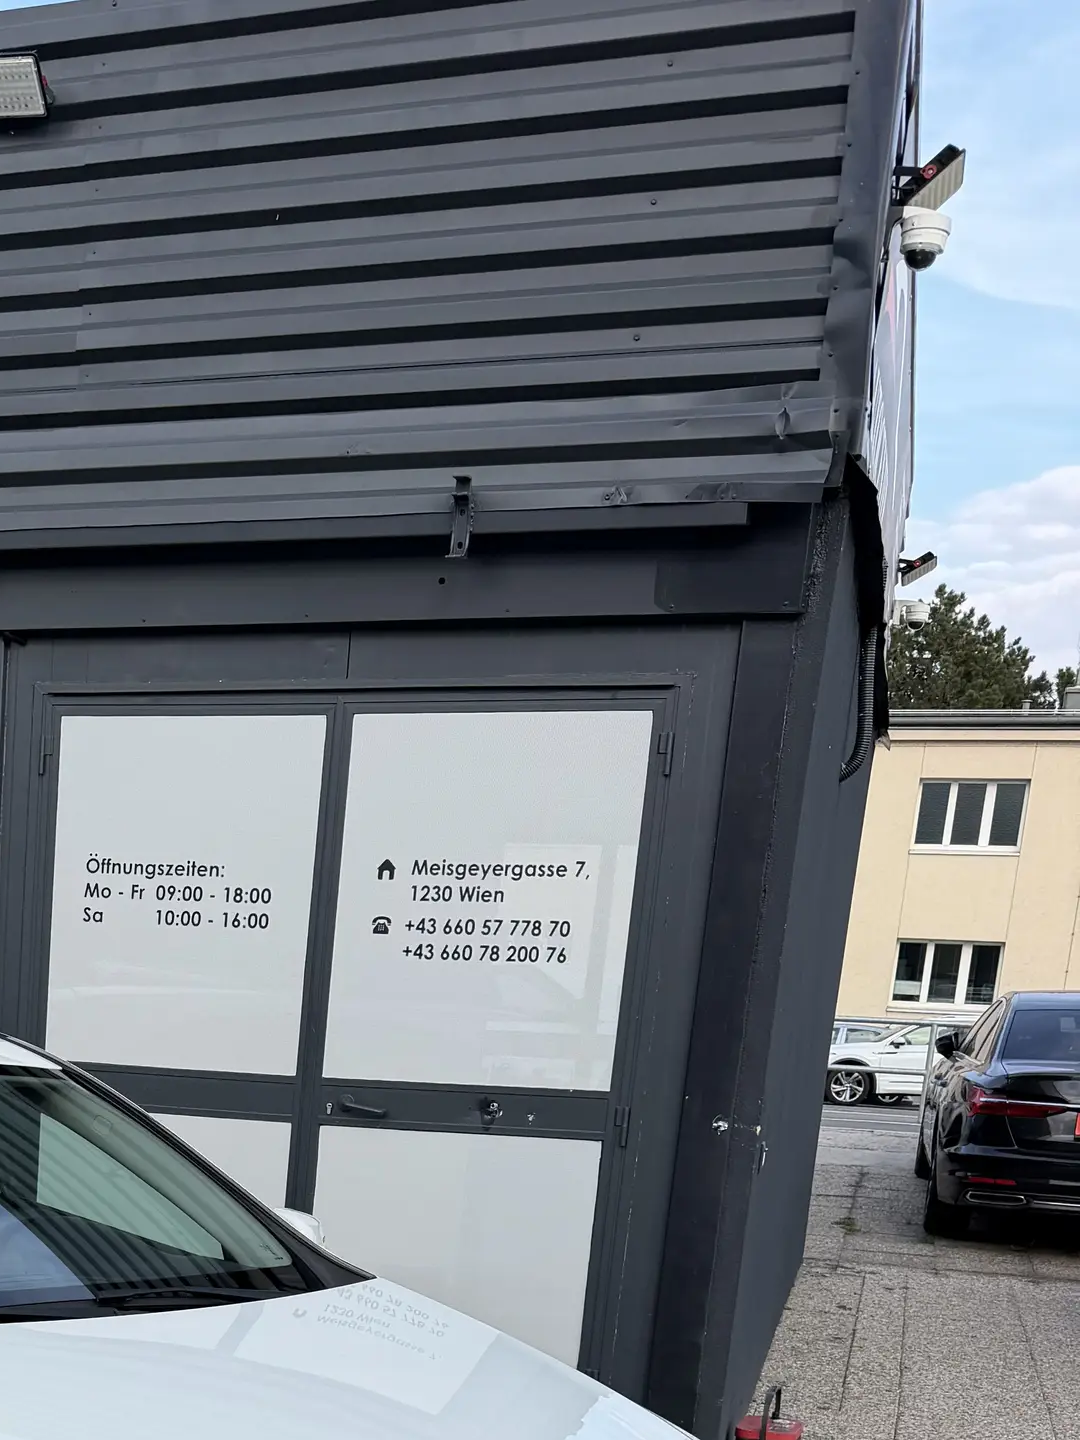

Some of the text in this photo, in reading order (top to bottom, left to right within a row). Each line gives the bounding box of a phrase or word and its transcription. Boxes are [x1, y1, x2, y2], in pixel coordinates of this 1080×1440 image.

[86, 853, 225, 880] Öffnungszeiten:
[411, 858, 590, 881] Meisgeyergasse 7,
[83, 883, 112, 899] Mo
[131, 884, 146, 900] Fr
[155, 885, 203, 902] 09:00
[223, 887, 272, 904] 18:00
[411, 885, 505, 903] 1230 Wien
[82, 906, 104, 923] Sa
[156, 910, 202, 927] 10:00
[222, 912, 269, 929] 16:00
[404, 917, 571, 937] +43 660 57 778 70
[402, 943, 567, 964] +43 660 78 200 76
